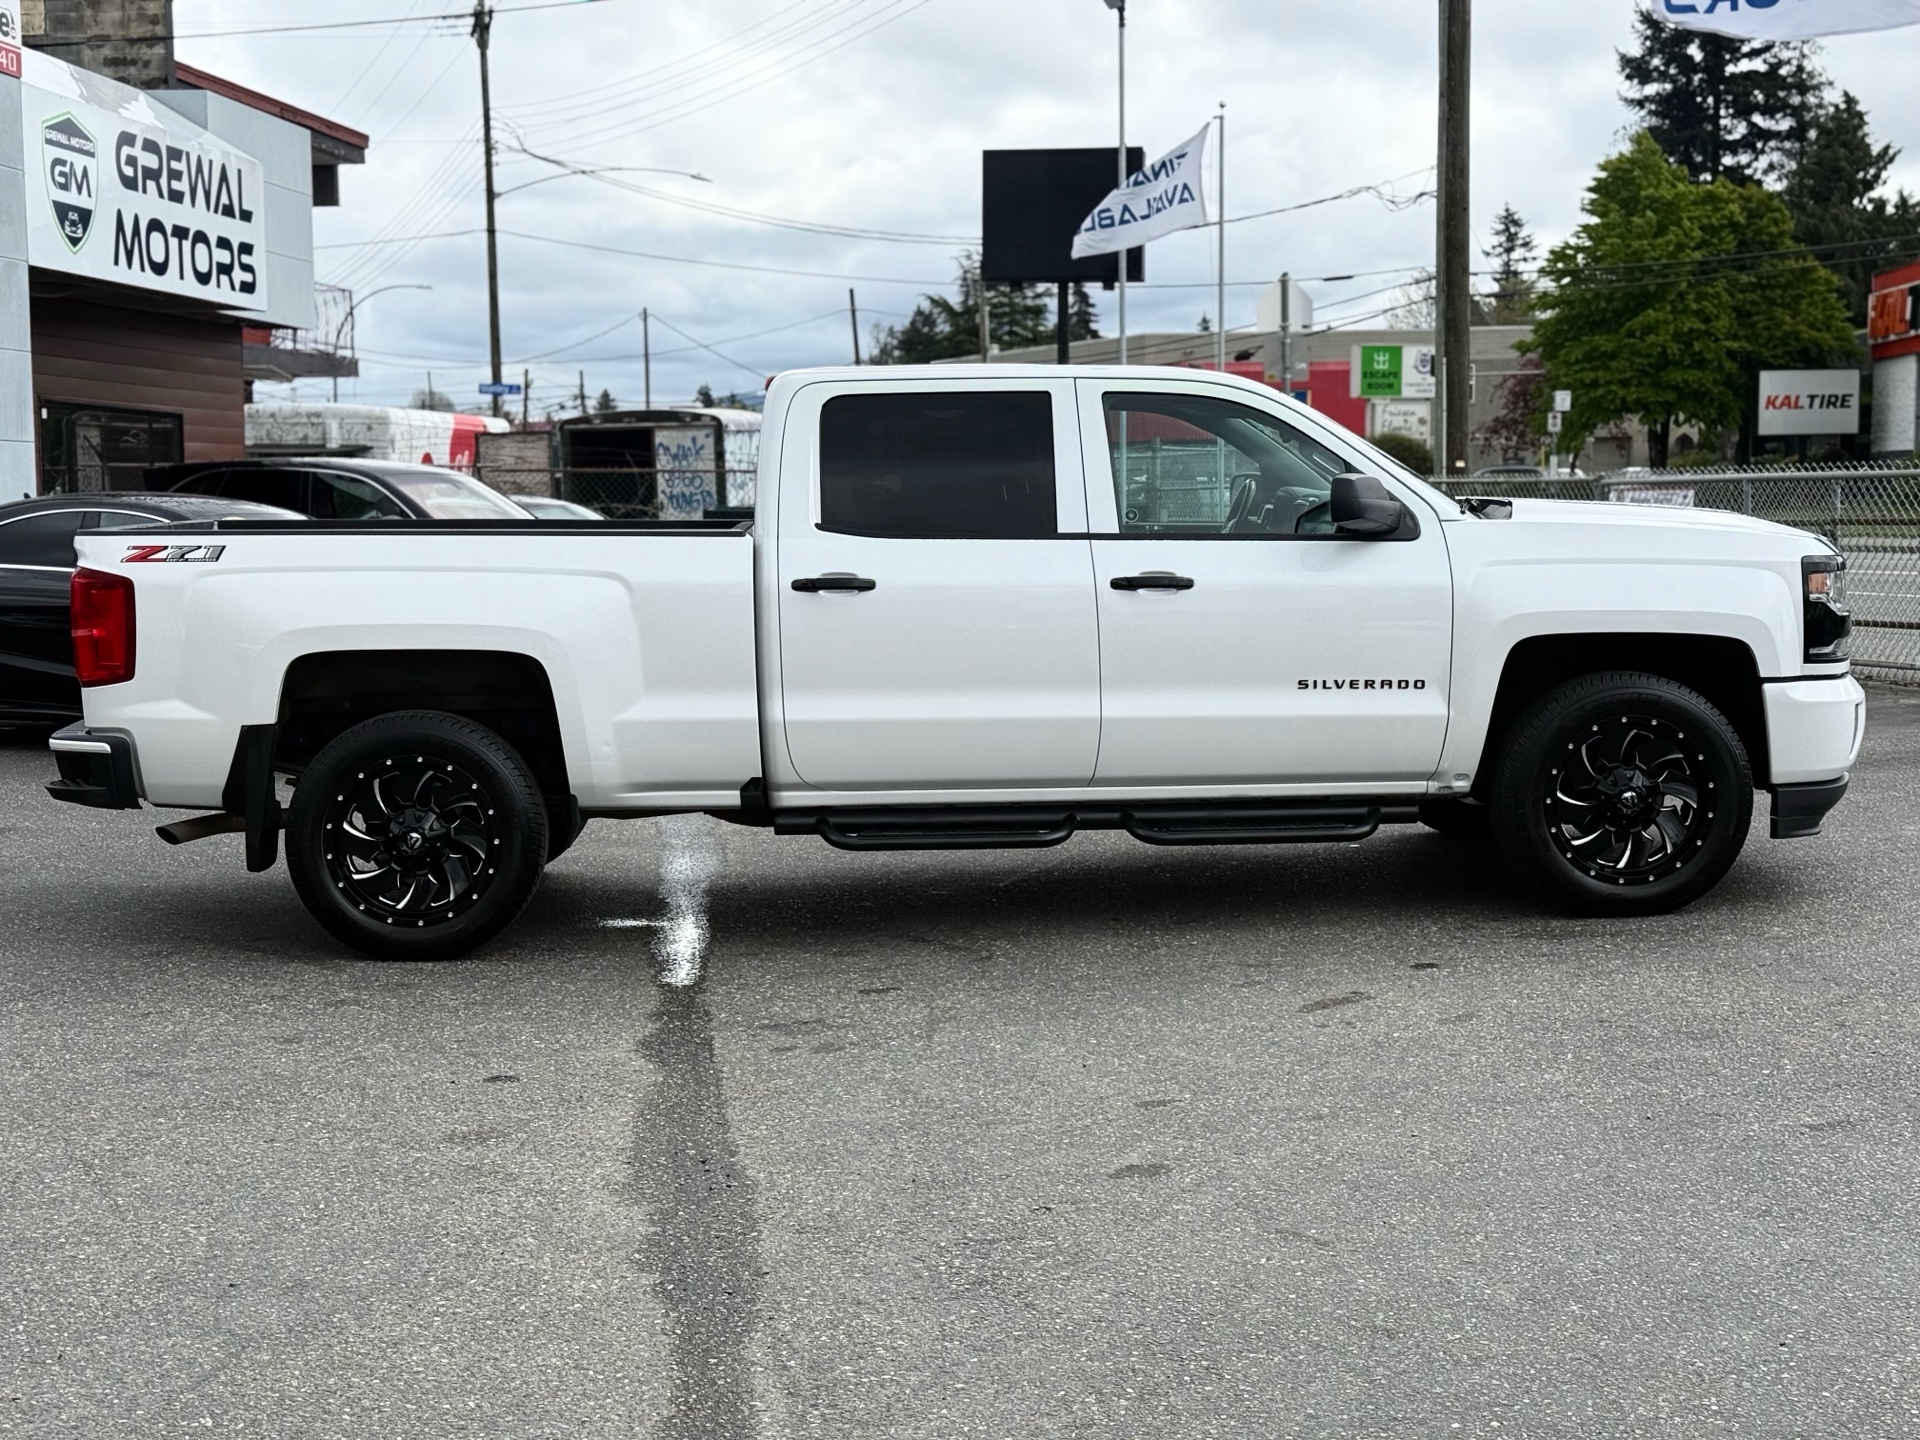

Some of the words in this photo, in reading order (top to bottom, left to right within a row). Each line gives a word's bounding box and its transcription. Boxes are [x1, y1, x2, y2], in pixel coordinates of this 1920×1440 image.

[45, 128, 70, 145] GREWAL
[70, 136, 95, 152] MOTORS
[50, 157, 92, 198] GM
[115, 130, 254, 224] GREWAL
[113, 207, 257, 295] MOTORS
[1363, 371, 1399, 379] ESCAPE
[1367, 382, 1394, 390] ROOM
[1764, 394, 1804, 410] KAL
[1806, 393, 1854, 410] TIRE
[120, 545, 226, 562] Z71
[1297, 679, 1426, 690] SILVERADO
